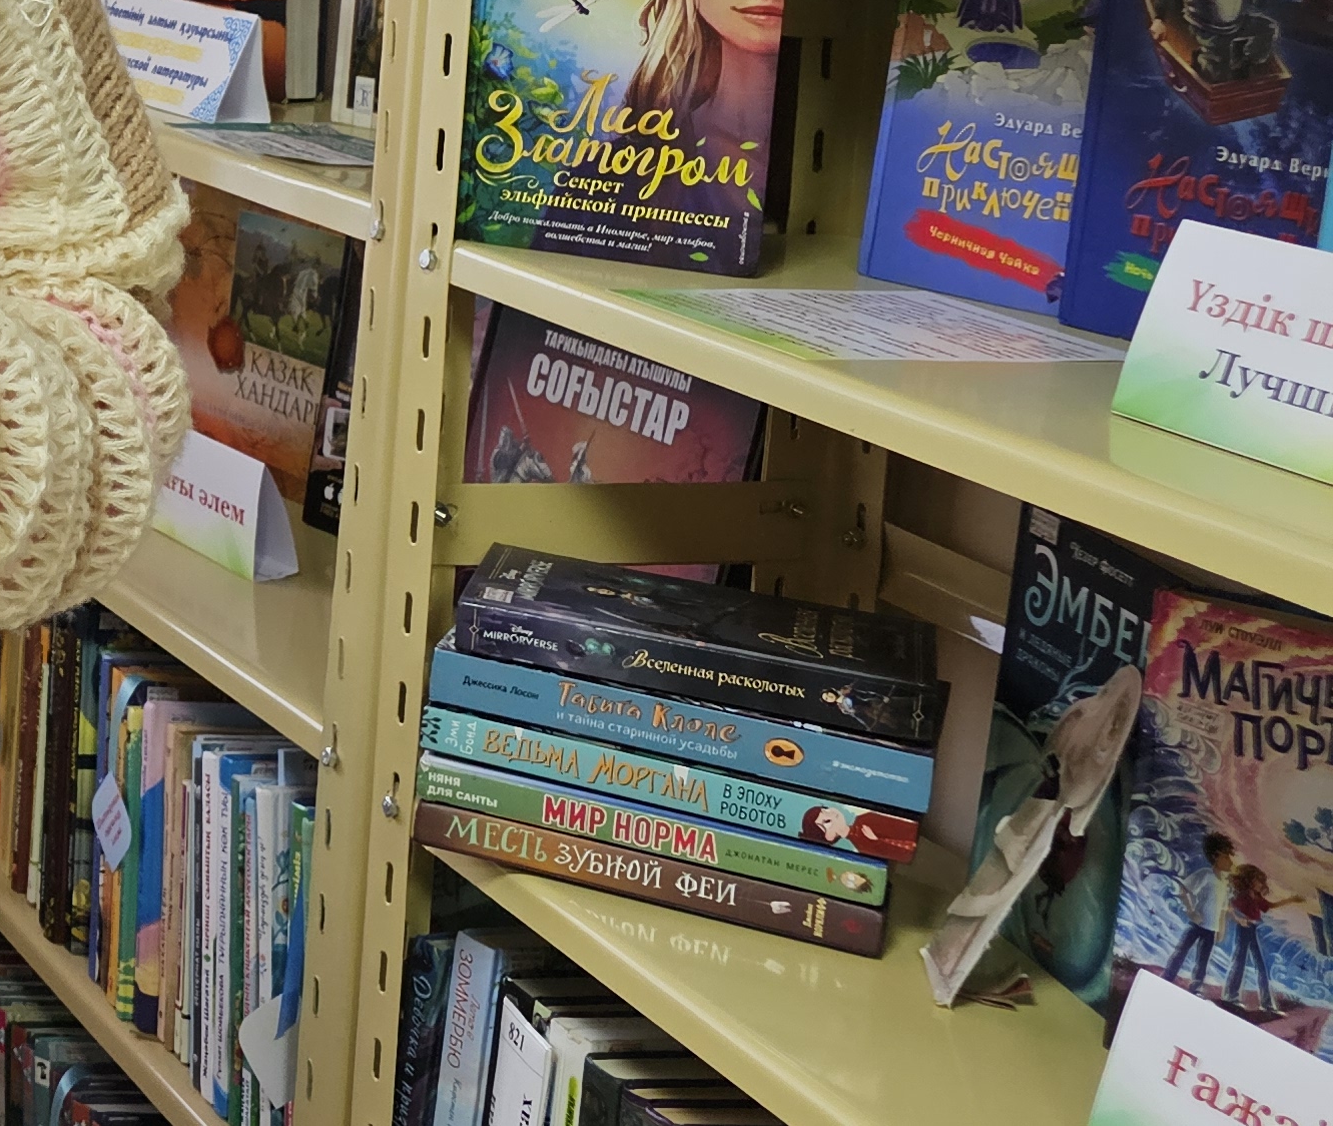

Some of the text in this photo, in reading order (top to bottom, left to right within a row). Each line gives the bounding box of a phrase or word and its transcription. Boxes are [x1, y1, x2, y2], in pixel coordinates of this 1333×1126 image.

[151, 64, 209, 91] литературы
[548, 69, 681, 141] Лиа
[993, 112, 1055, 137] Эдуард
[475, 89, 754, 201] Златогром
[1215, 145, 1283, 172] Эдуард
[553, 170, 625, 196] Секрет
[500, 187, 731, 230] эльфийской принцессы
[488, 210, 521, 223] Добро
[522, 215, 586, 233] пожаловать
[651, 234, 674, 245] мир
[544, 230, 607, 248] волшебства
[616, 240, 653, 253] магии!
[1187, 278, 1296, 338] Үздік
[544, 329, 693, 394] ТАРИХЫНДАҒЫ АТЫШУЛЫ
[526, 353, 691, 446] СОҒЫСТАР
[1198, 348, 1333, 419] Лучш
[199, 488, 245, 526] әлем
[483, 630, 559, 652] MIRRORVERSE
[462, 675, 507, 694] Джессика
[622, 649, 807, 700] Вселенная расколотых
[558, 680, 642, 720] Табита
[444, 720, 461, 748] Эми
[459, 721, 477, 755] Бонд
[556, 711, 737, 760] и тайна старинной усадьбы
[428, 772, 461, 787] НЯНЯ
[483, 729, 709, 814] ВЕДЬМА МОРГАНА
[426, 785, 499, 809] ДЛЯ САНТЫ
[722, 783, 783, 811] В ЭПОХУ
[542, 795, 720, 865] МИР НОРМА
[720, 802, 787, 829] РОБОТОВ
[445, 814, 737, 907] МЕСТЬ ЗУБНОЙ ФЕИ
[725, 847, 820, 877] ДЖОНАТАН МЕРЕС
[404, 975, 432, 1059] Девочка
[446, 948, 474, 1070] ЗОММЕРБЮ
[508, 1022, 526, 1052] 821
[404, 1062, 416, 1077] и
